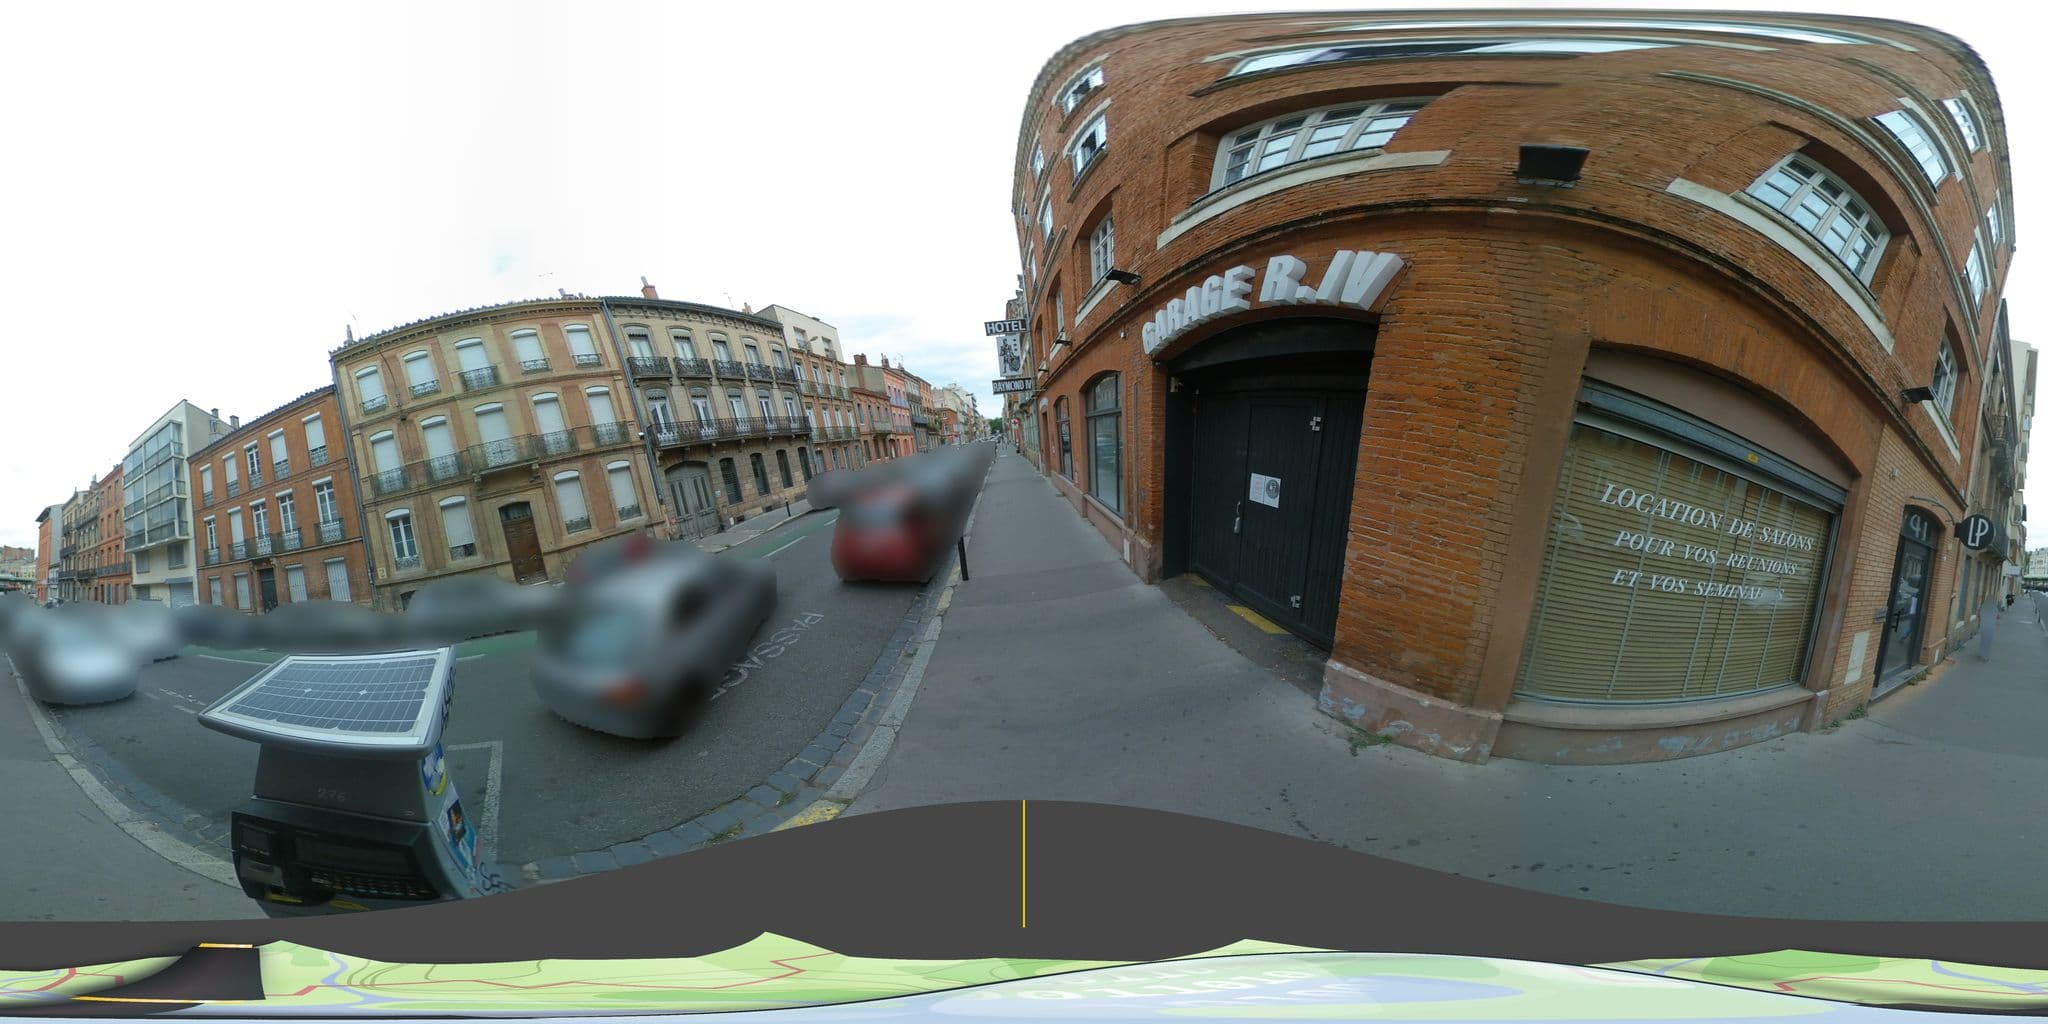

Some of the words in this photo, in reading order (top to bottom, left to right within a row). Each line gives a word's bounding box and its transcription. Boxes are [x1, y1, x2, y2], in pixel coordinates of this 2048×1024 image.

[1141, 264, 1256, 355] GARAGE
[987, 321, 1026, 333] HOTEL
[993, 381, 1024, 392] RAYMOND
[1025, 379, 1032, 390] IV
[1600, 483, 1725, 530] LOCATION
[1727, 518, 1756, 538] DE
[1759, 526, 1815, 552] SALONS
[1967, 517, 1989, 547] LP
[1614, 530, 1676, 557] POUR
[1682, 544, 1719, 565] VOS
[1726, 552, 1800, 576] REUNIONS
[1611, 568, 1643, 588] ET
[1649, 574, 1688, 594] VOS
[1693, 581, 1785, 601] SEMINAIS
